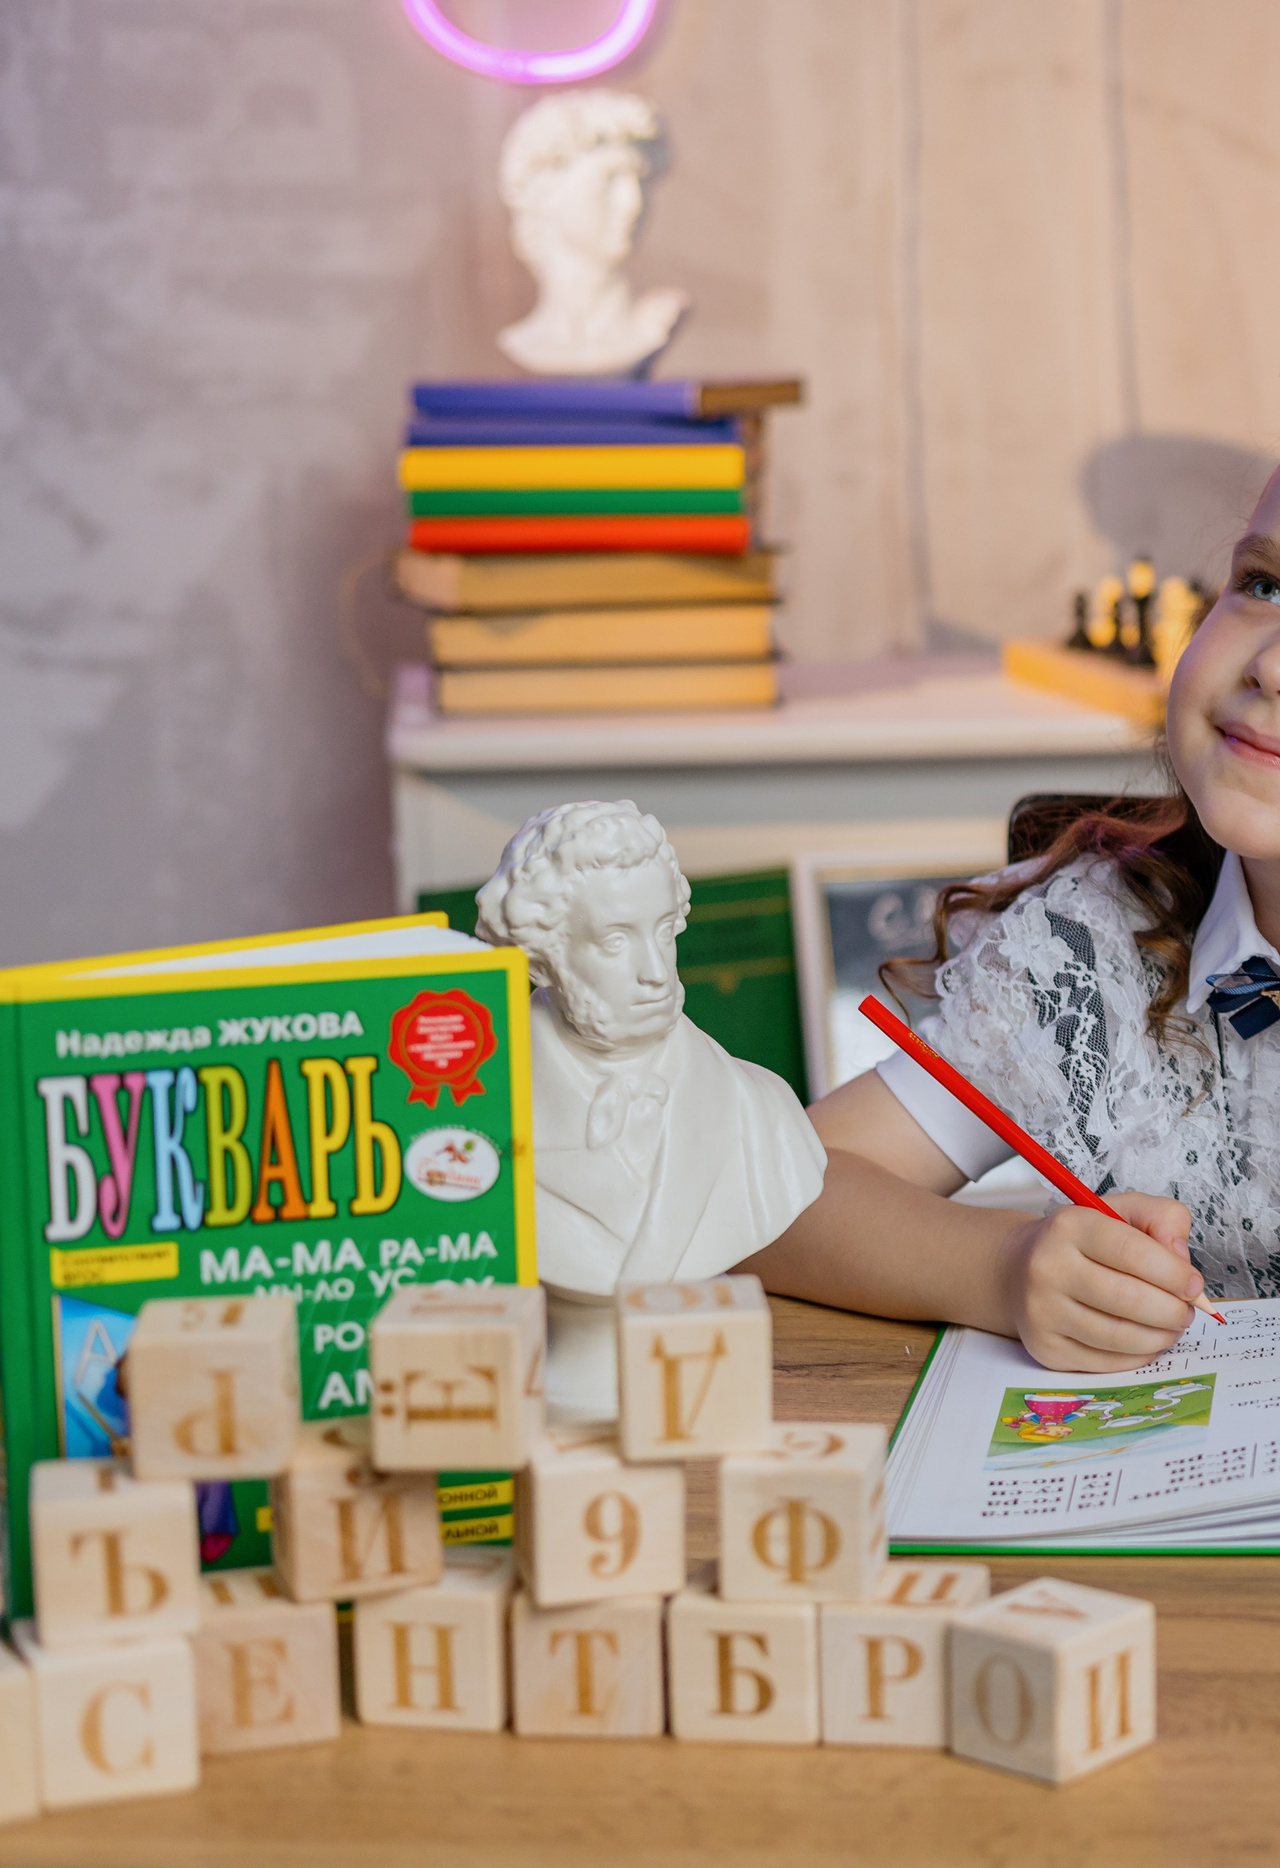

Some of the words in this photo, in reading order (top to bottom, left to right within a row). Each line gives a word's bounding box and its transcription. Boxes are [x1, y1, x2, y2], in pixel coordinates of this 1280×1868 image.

[55, 1024, 212, 1061] Надежда
[218, 1009, 365, 1047] ЖУКОВА
[37, 1054, 403, 1244] БУКВАРЬ
[200, 1237, 366, 1285] МА-МА
[379, 1230, 499, 1268] РА-МА
[1239, 1352, 1274, 1361] гру
[982, 1507, 1056, 1517] но-га
[987, 1496, 1061, 1506] го-ра
[989, 1477, 1065, 1486] но-ги
[68, 1526, 171, 1619] Ъ
[324, 1492, 414, 1584] И
[751, 1497, 843, 1584] Ф
[224, 1636, 297, 1730] Е
[383, 1621, 468, 1716] Н
[547, 1628, 620, 1717] Т
[707, 1630, 775, 1716] Б
[856, 1633, 925, 1721] Р
[79, 1680, 156, 1777] С
